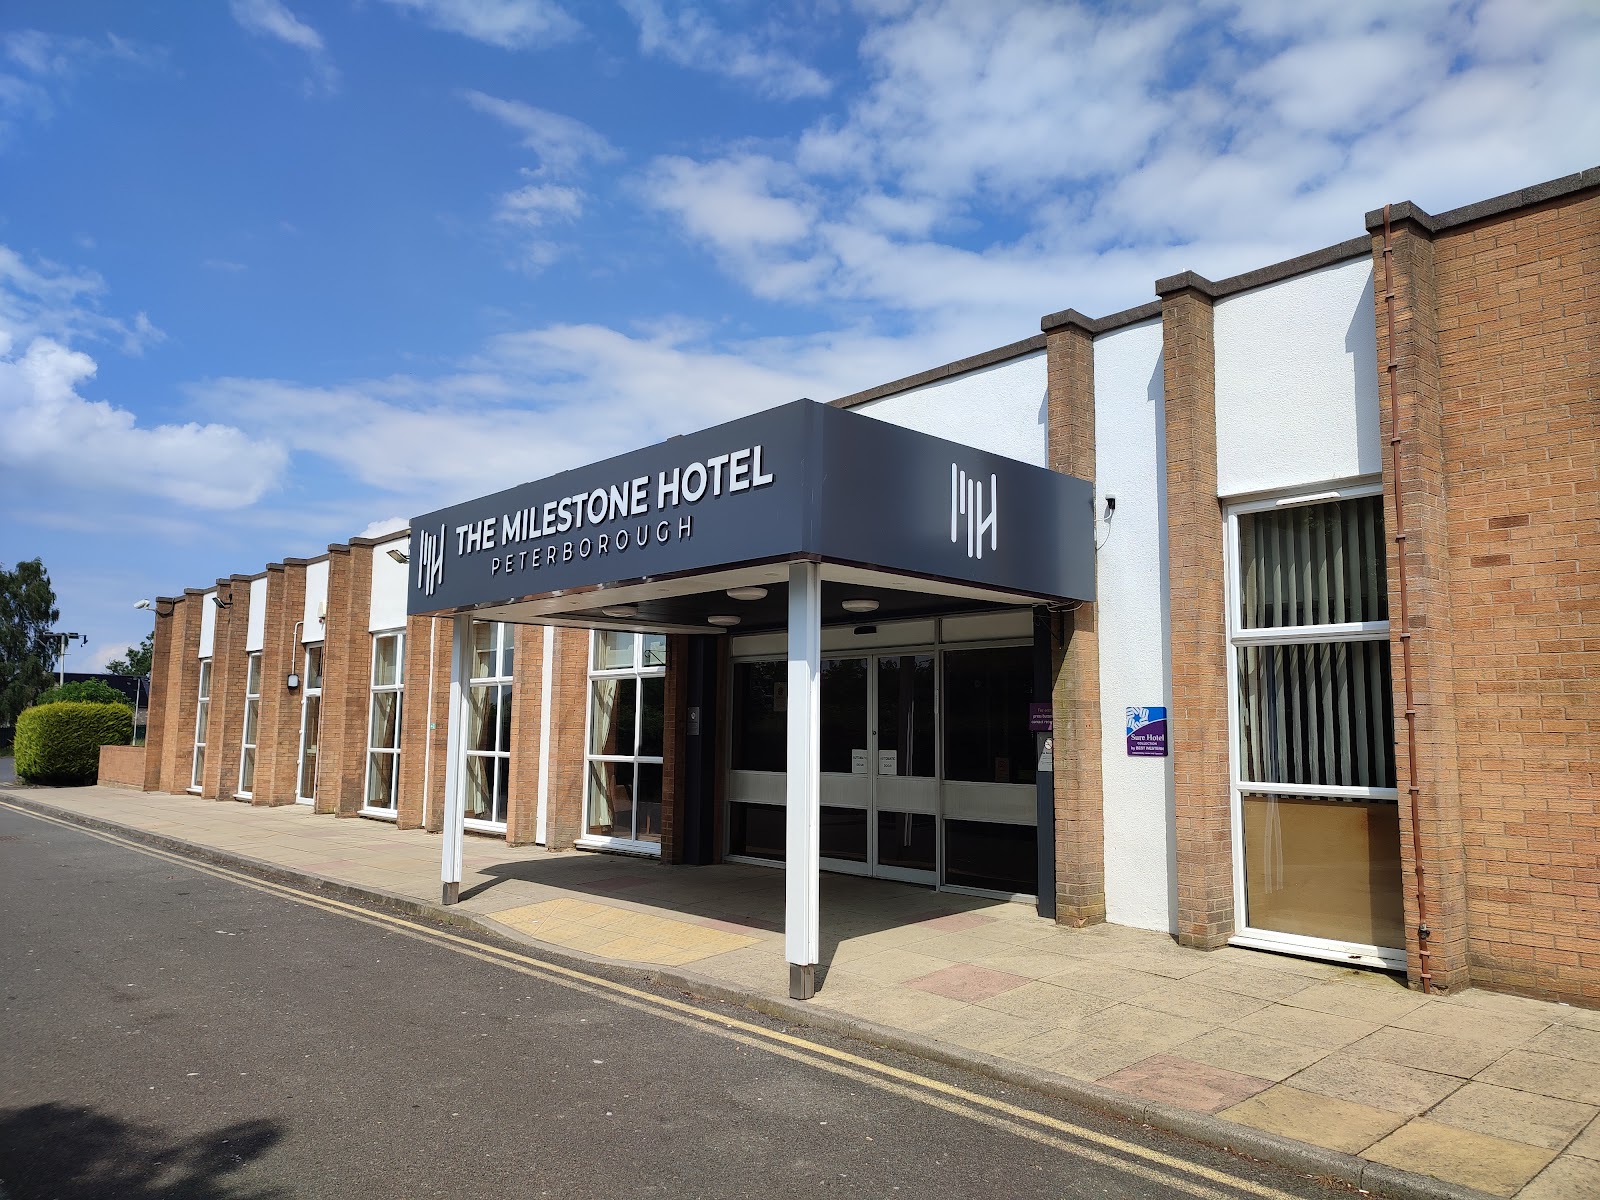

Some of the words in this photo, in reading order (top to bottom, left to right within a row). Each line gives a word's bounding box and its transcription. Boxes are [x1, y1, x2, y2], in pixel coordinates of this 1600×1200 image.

[455, 517, 496, 556] THE
[501, 475, 649, 546] MILESTONE
[656, 445, 774, 509] HOTEL
[491, 515, 693, 576] PETERBOROUGH
